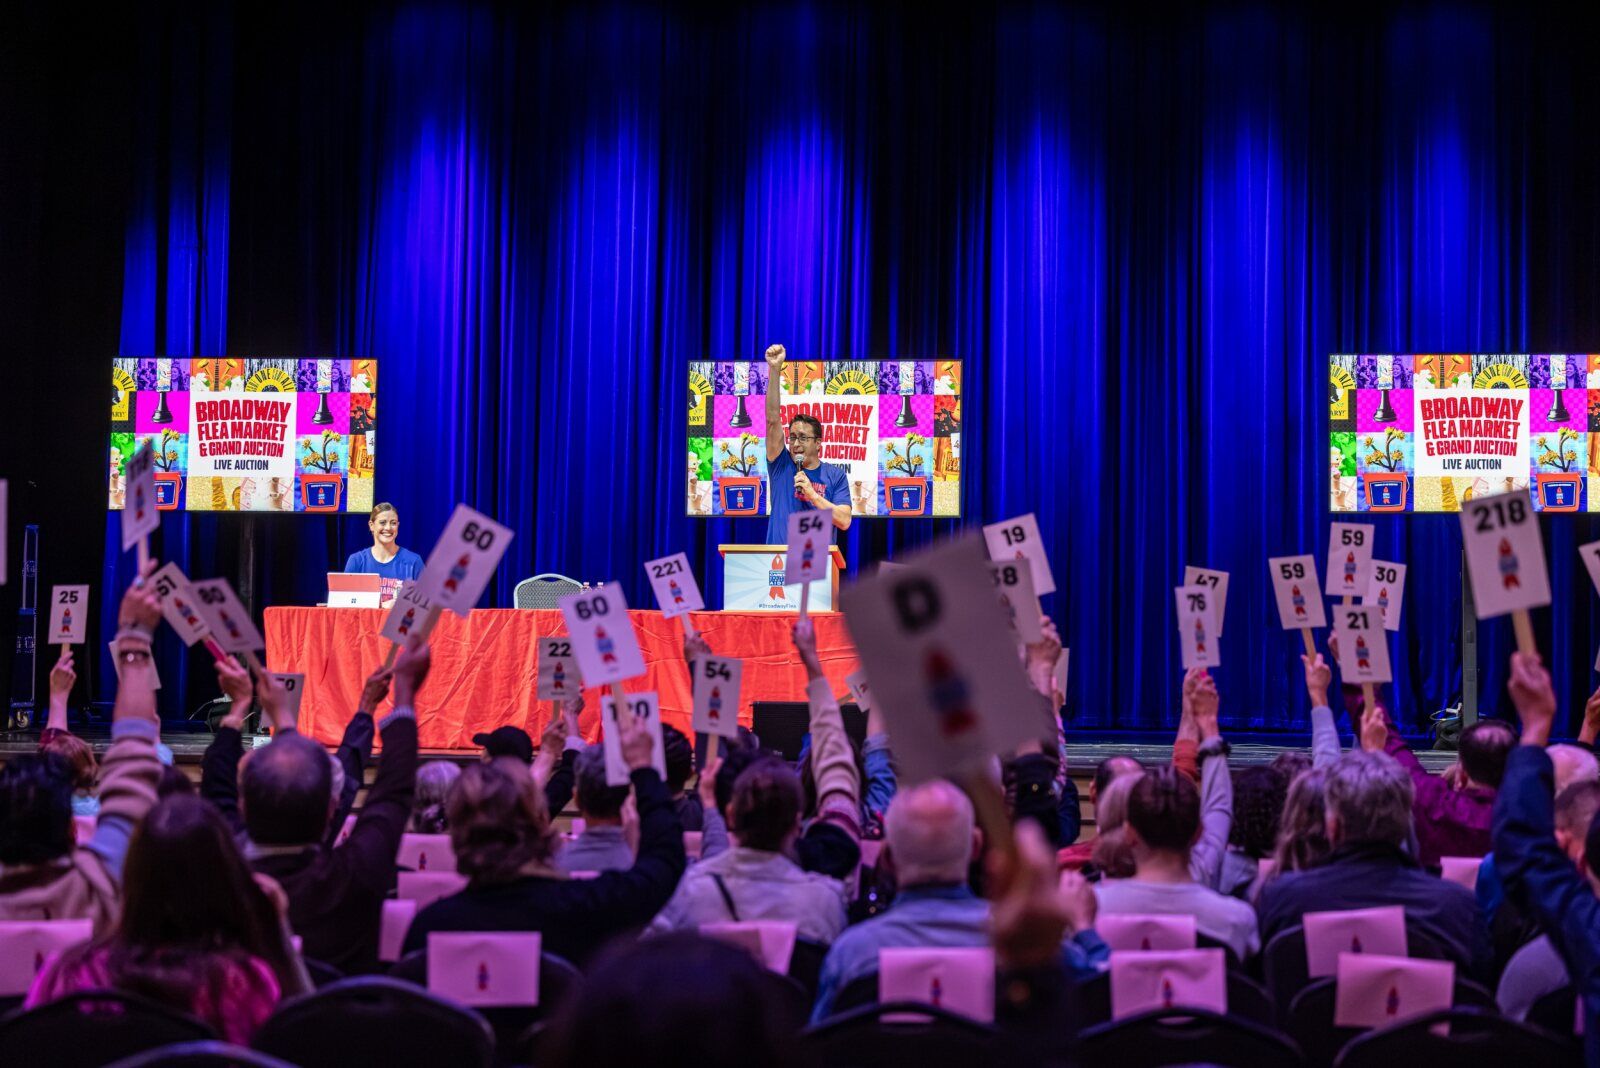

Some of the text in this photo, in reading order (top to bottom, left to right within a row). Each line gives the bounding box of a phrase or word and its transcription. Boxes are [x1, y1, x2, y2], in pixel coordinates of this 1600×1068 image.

[195, 399, 292, 422] BROADWAY
[1420, 397, 1524, 420] BROADWAY
[197, 421, 288, 441] FLEA MARKET
[821, 425, 870, 445] ARKET
[1423, 419, 1520, 440] FLEA MARKET
[199, 441, 285, 457] & GRAND AUCTION
[824, 445, 867, 461] AUCTION
[1425, 440, 1518, 457] & GRAND AUCTION
[214, 459, 269, 470] LIVE AUCTION
[1442, 459, 1502, 470] LIVE AUCTION
[798, 515, 824, 534] 54
[1473, 498, 1526, 533] 218
[462, 521, 495, 551] 60
[1001, 525, 1026, 547] 19
[1341, 529, 1364, 547] 59
[652, 559, 684, 579] 221
[1279, 562, 1305, 580] 59
[1375, 565, 1397, 584] 30
[1195, 574, 1219, 590] 47
[59, 590, 79, 604] 25
[1186, 592, 1207, 612] 76
[575, 595, 609, 621] 60
[1346, 611, 1370, 630] 21
[548, 642, 572, 657] 22
[705, 660, 732, 682] 54
[607, 700, 651, 722] 10
